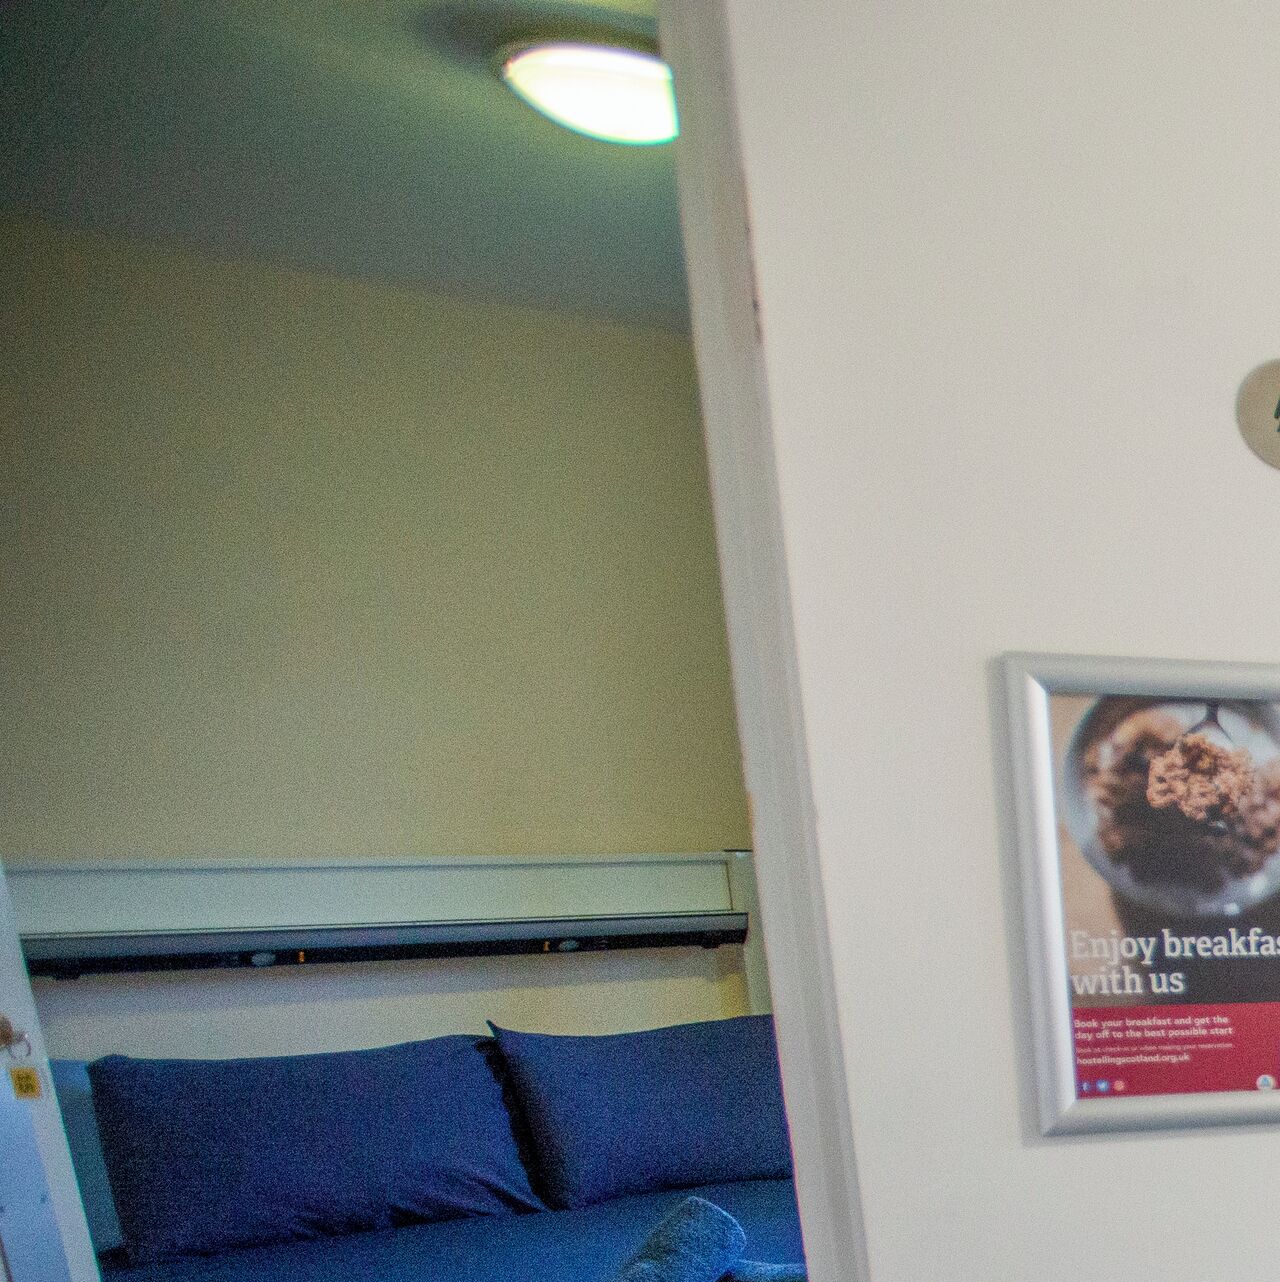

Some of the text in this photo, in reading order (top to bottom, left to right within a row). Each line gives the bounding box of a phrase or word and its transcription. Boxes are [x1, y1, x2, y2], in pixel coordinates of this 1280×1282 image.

[1070, 929, 1155, 965] Enjoy
[1071, 965, 1184, 995] with us
[1074, 1014, 1229, 1030] Book your breakfast and get the
[1075, 1026, 1233, 1041] day off to the best possible start
